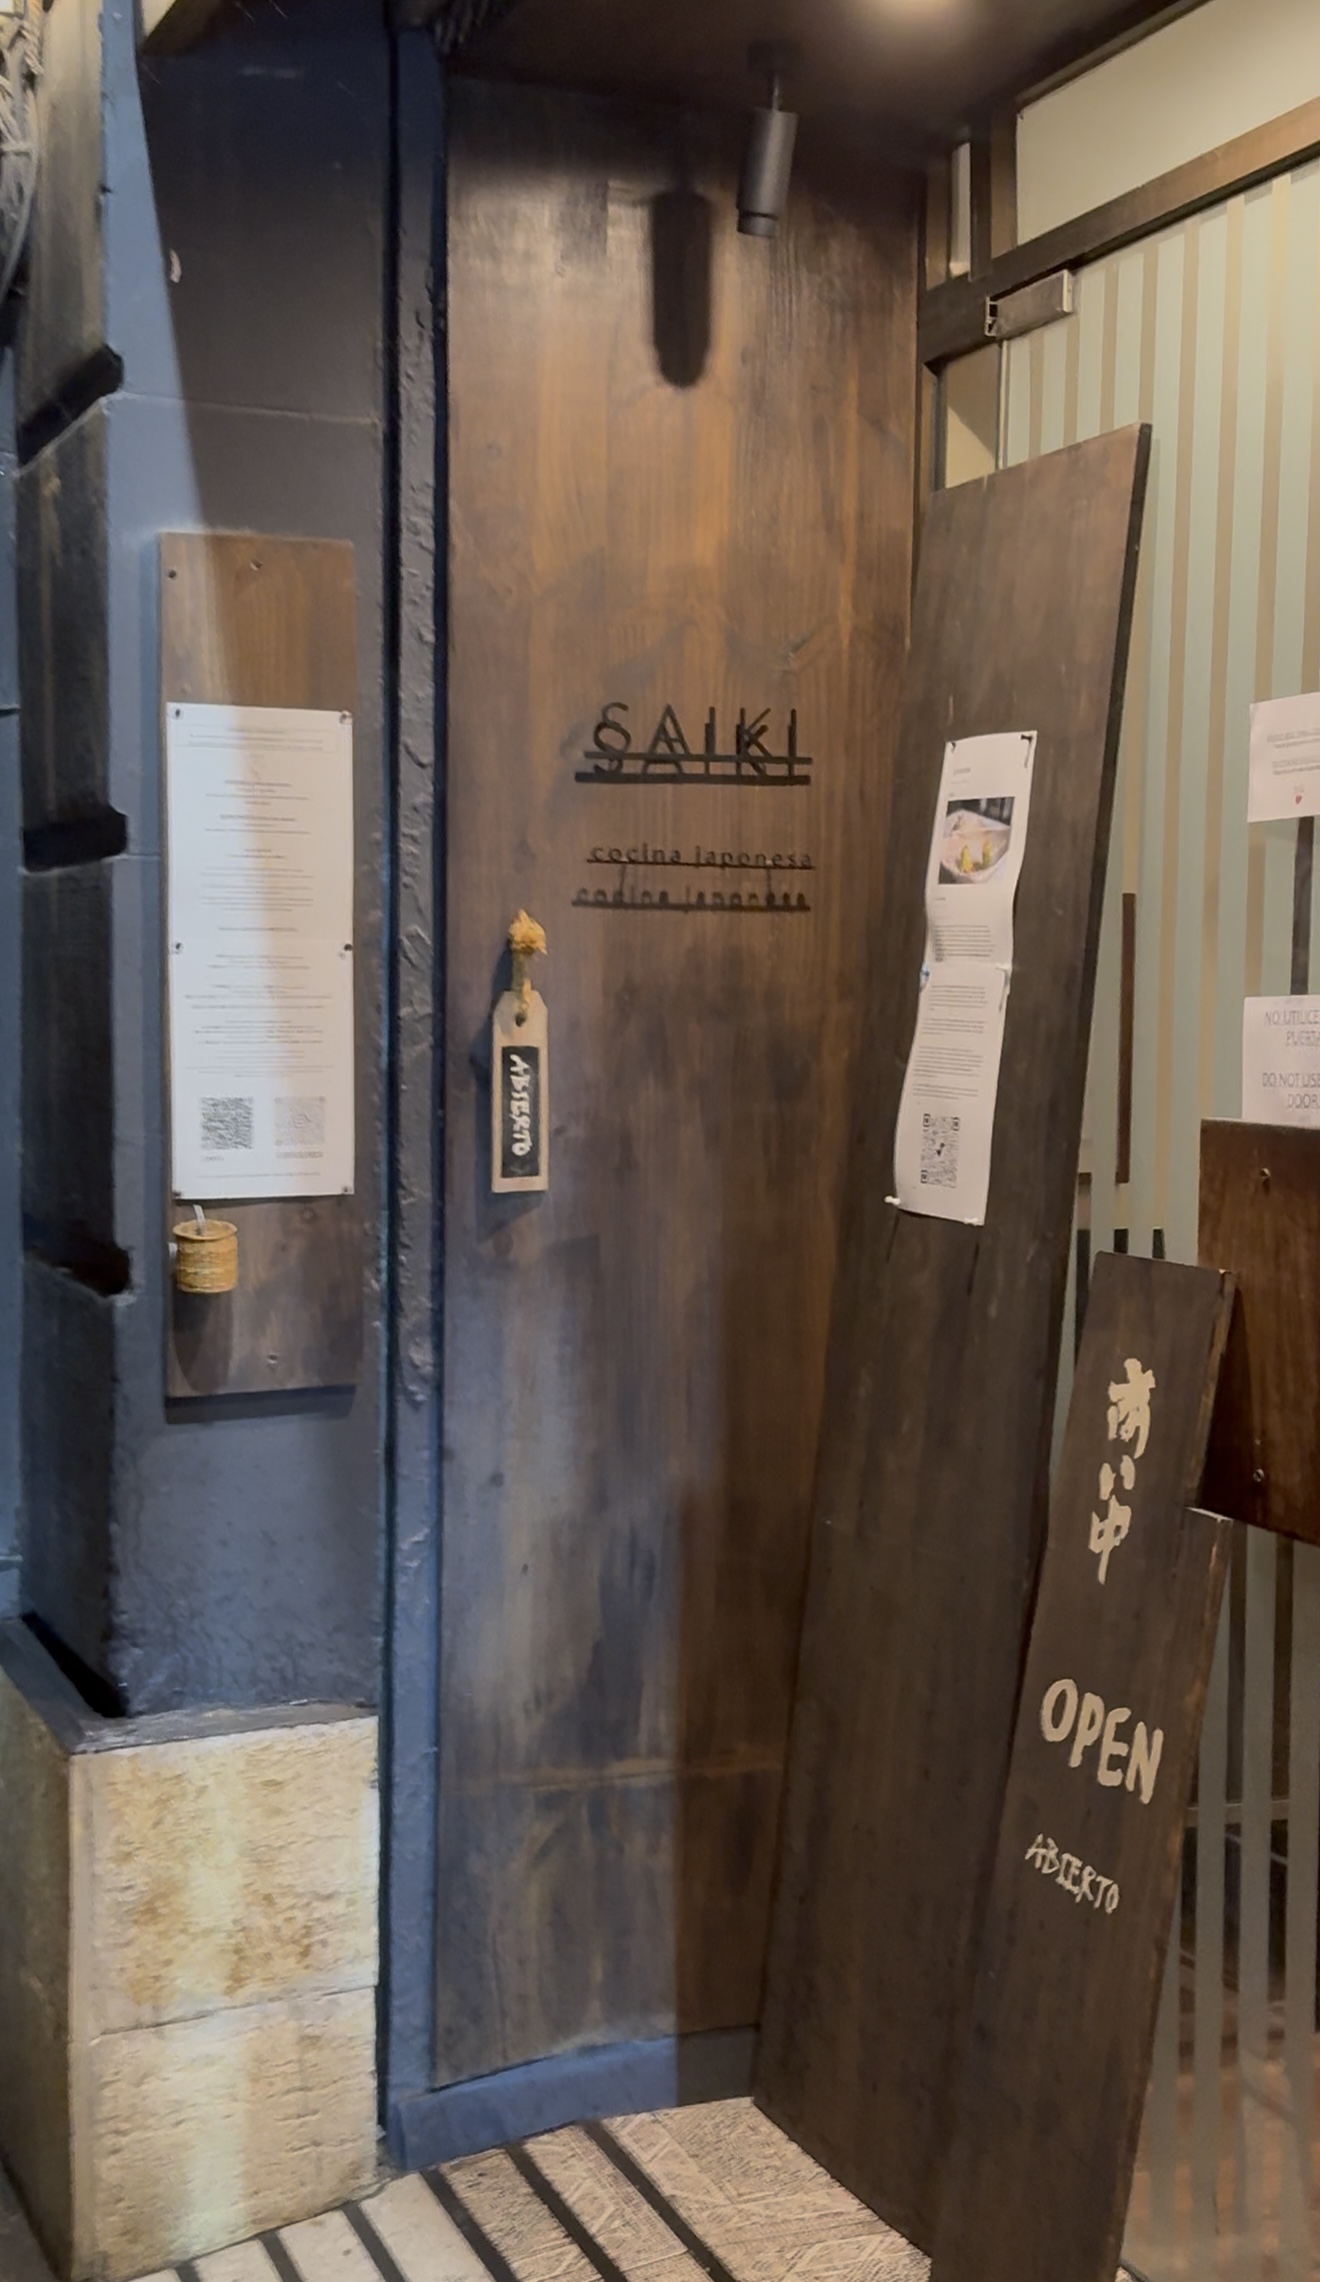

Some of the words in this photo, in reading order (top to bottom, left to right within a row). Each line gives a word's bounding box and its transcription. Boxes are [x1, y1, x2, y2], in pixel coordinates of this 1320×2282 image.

[592, 701, 799, 760] SAIKI
[589, 842, 681, 864] cocina
[694, 844, 813, 869] japonesa
[1264, 1010, 1280, 1026] NO
[1262, 1072, 1277, 1088] DO
[1279, 1072, 1300, 1088] NOT
[1041, 1678, 1164, 1805] OPEN
[1024, 1832, 1120, 1915] ABIERTO
